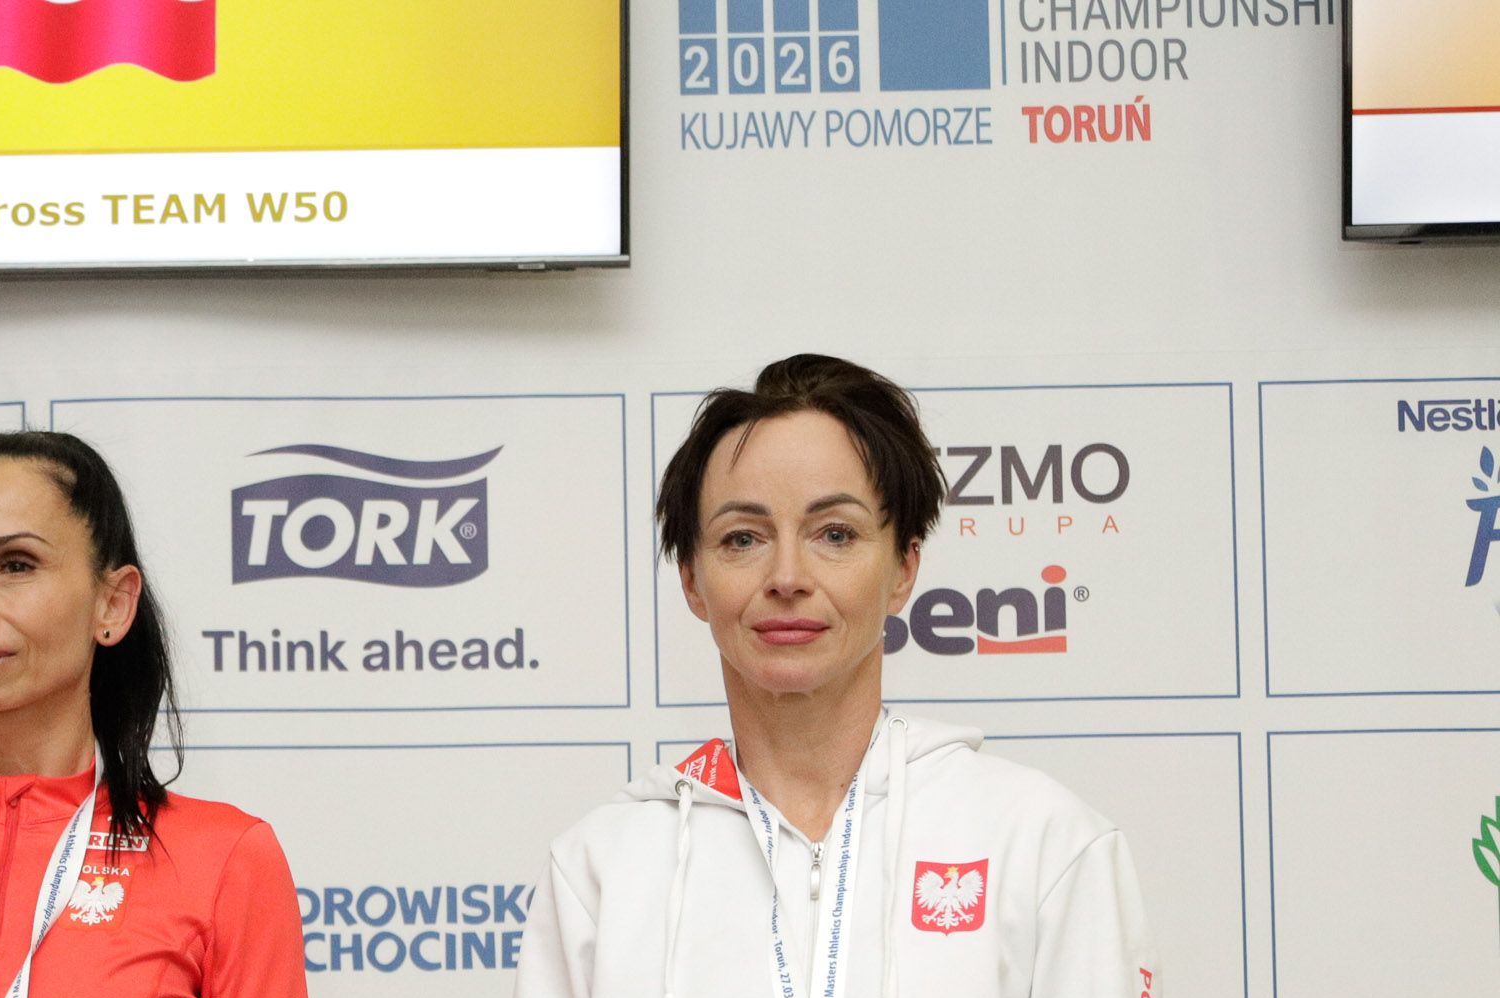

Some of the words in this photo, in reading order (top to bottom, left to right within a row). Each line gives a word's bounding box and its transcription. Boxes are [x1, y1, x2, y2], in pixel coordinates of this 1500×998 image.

[681, 42, 858, 91] 2026
[1021, 39, 1188, 83] INDOOR
[681, 111, 815, 151] KUJAWY
[826, 107, 992, 147] POMORZE
[1022, 95, 1151, 144] TORUŃ
[102, 193, 225, 224] TEAM
[246, 191, 347, 222] W50
[932, 442, 1131, 508] ZMO
[240, 495, 479, 569] TORK
[202, 629, 347, 671] Think
[363, 628, 539, 671] ahead.
[832, 852, 850, 920] Championships
[828, 920, 841, 959] Athletics
[824, 960, 836, 998] Masters
